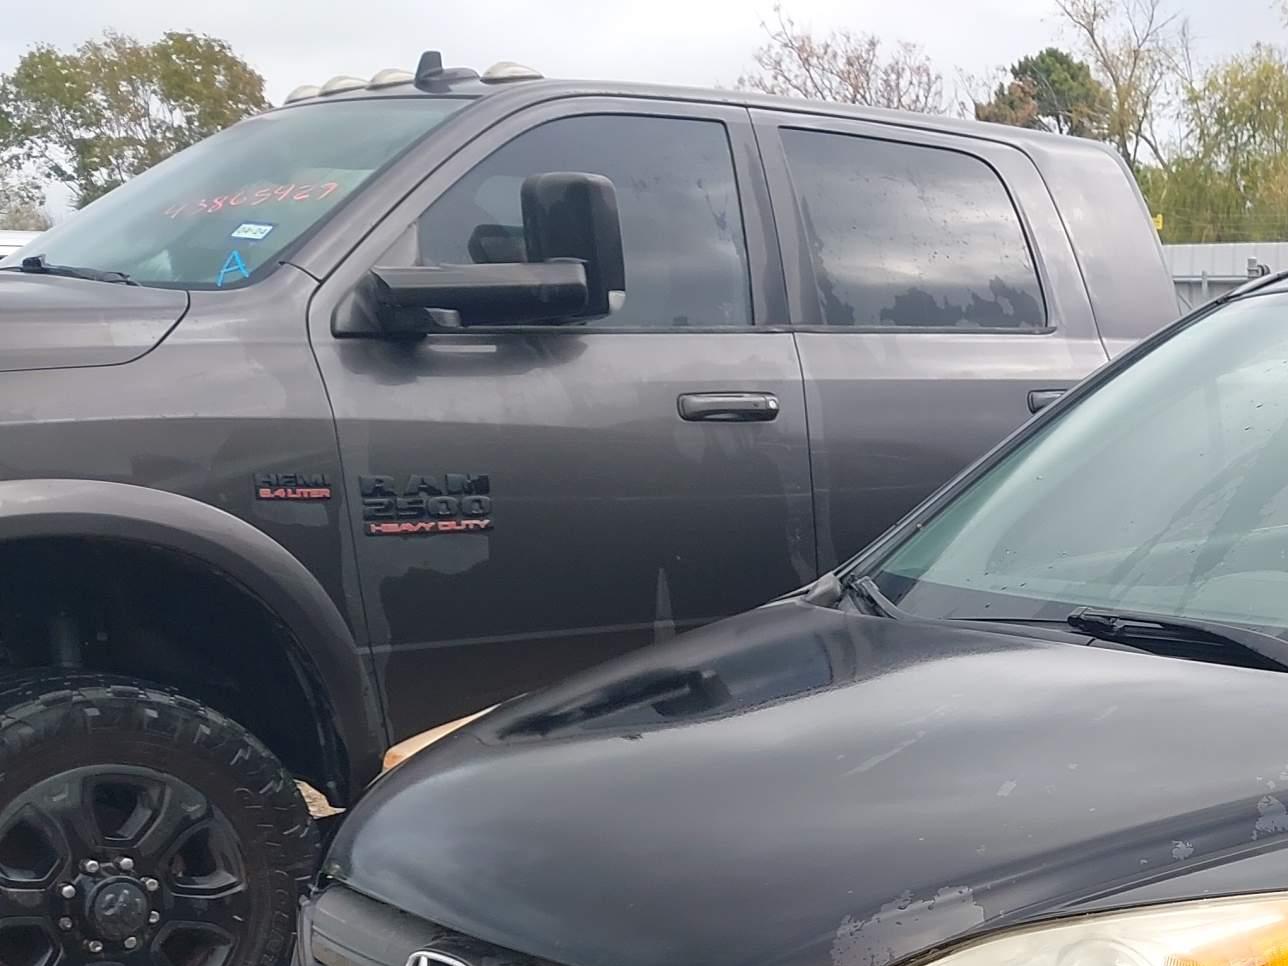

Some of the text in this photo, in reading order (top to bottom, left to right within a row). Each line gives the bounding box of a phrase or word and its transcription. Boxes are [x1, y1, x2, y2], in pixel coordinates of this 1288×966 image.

[217, 249, 249, 287] A
[253, 473, 332, 487] HEMI
[358, 474, 491, 496] RAM
[286, 488, 332, 498] LITER
[362, 496, 492, 520] 2500
[370, 518, 491, 534] HEAVY DUTY
